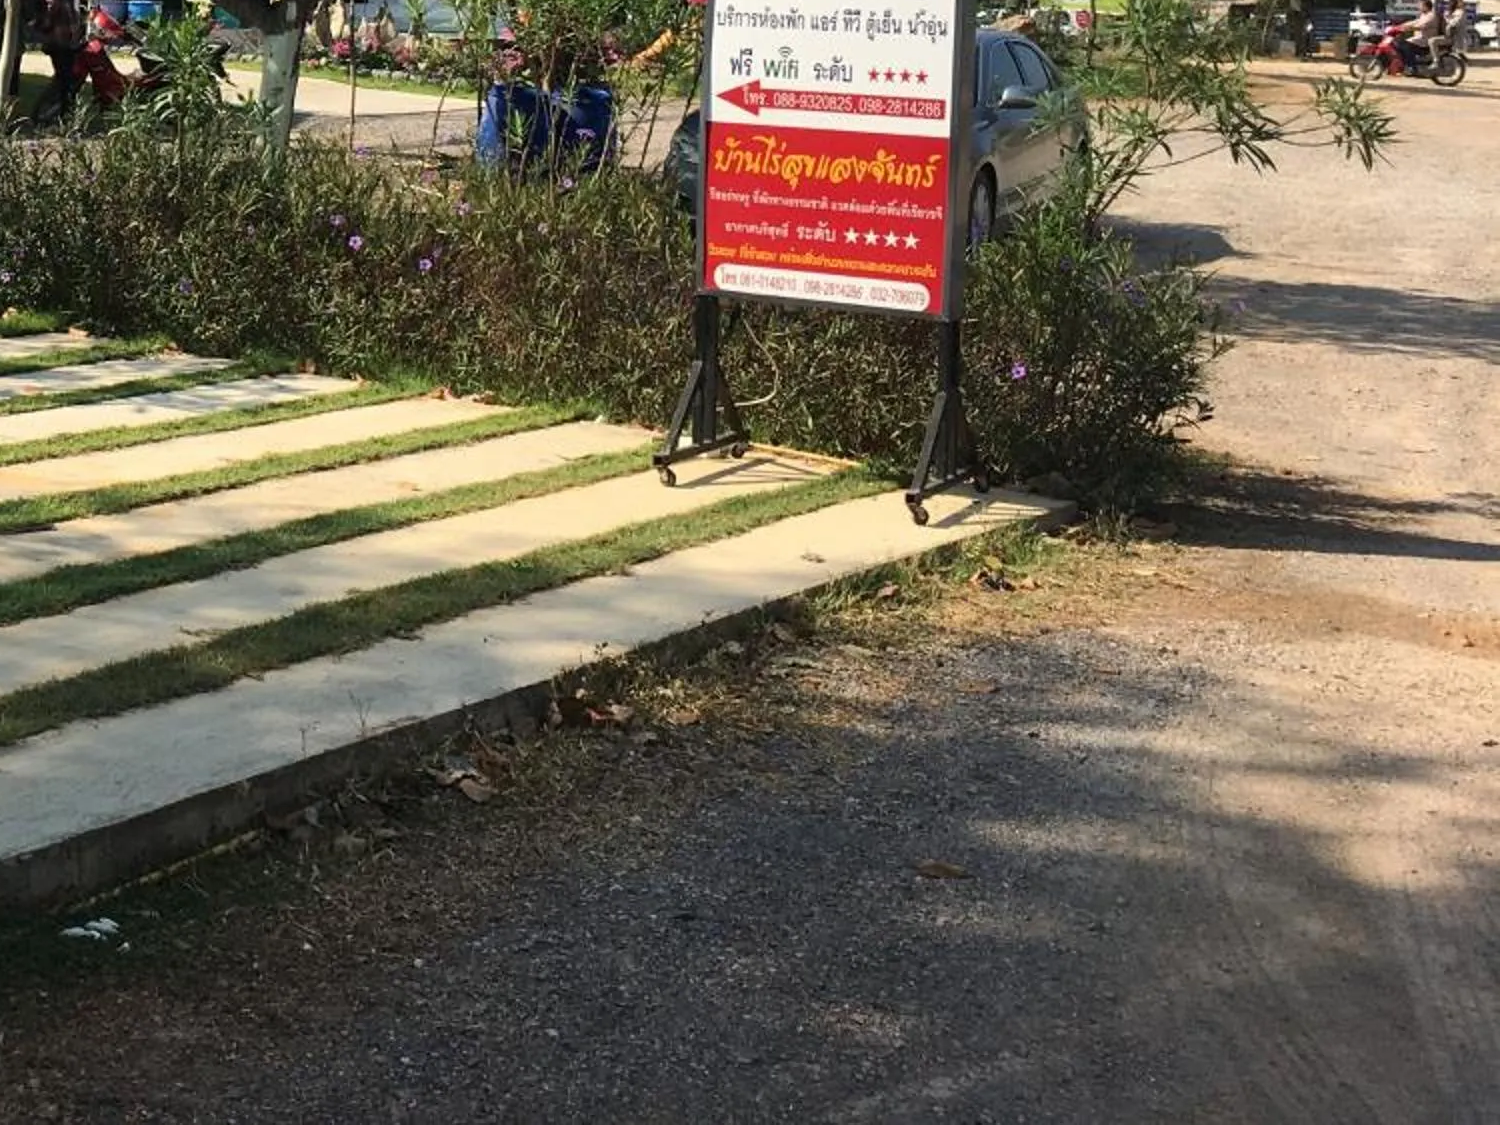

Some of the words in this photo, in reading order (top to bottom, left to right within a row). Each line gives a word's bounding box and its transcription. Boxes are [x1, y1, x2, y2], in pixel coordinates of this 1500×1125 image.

[717, 4, 805, 30] บริการห้องพัก
[810, 10, 839, 32] แอร์
[843, 8, 861, 33] ทีวี
[866, 10, 902, 41] ตู้เย็น
[908, 9, 948, 43] น้ำอุ่น
[730, 48, 753, 76] ฟรี
[813, 56, 853, 82] ระดับ
[714, 135, 942, 191] บ้านไร่สุขแสงจันทร์
[796, 220, 836, 243] ระดับ
